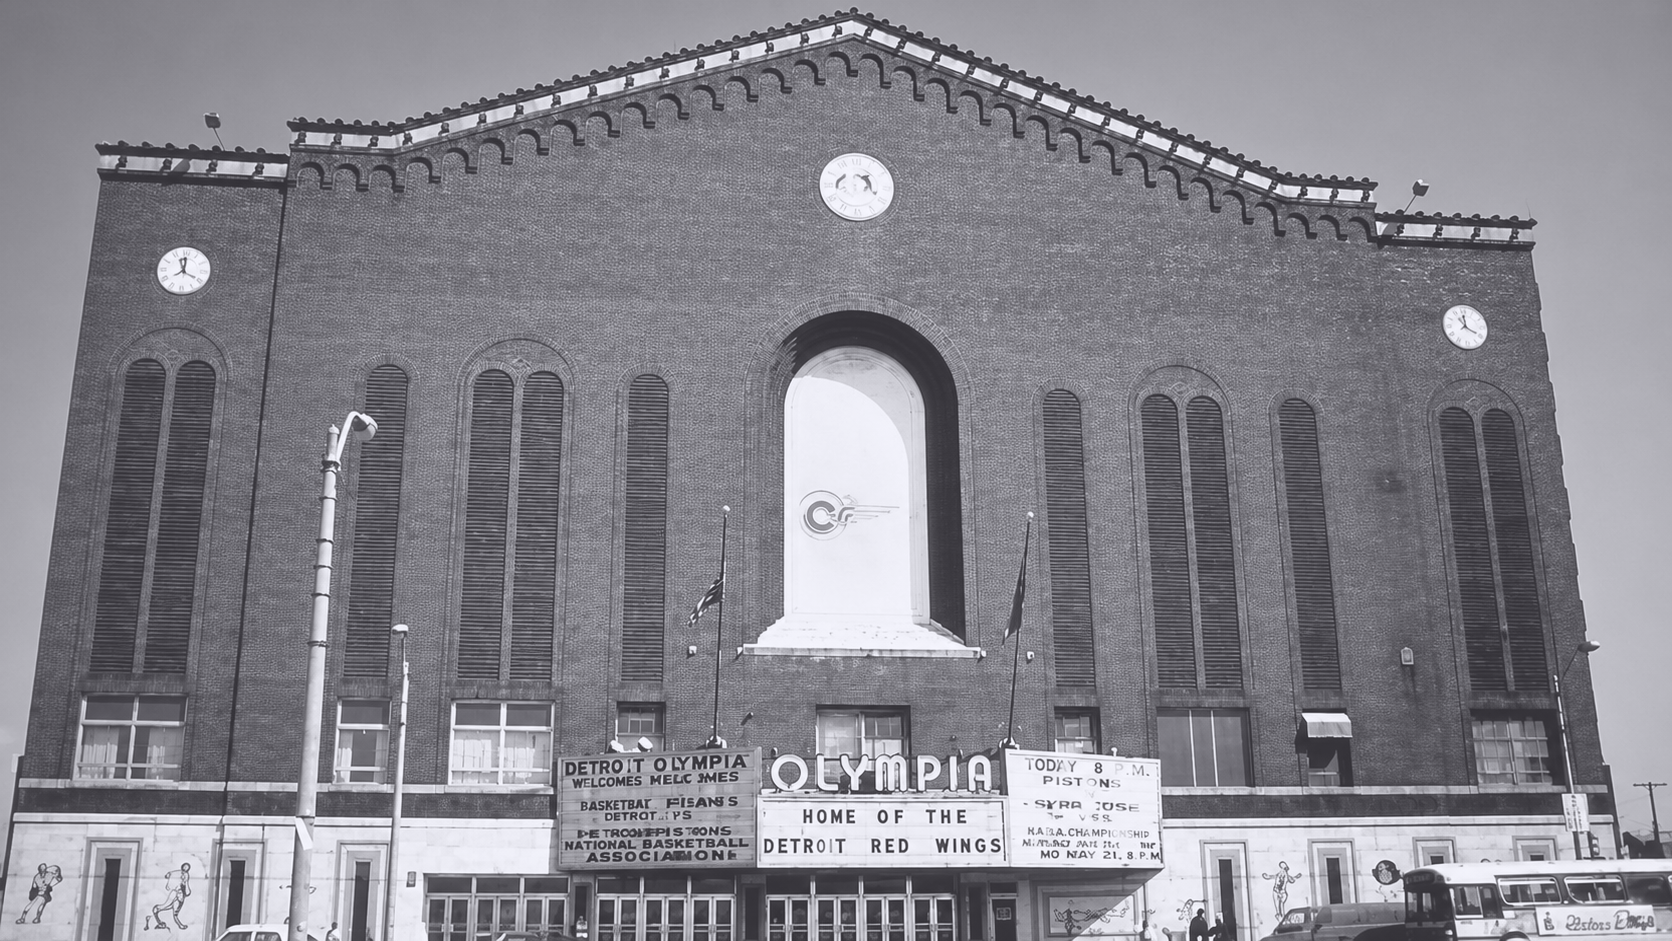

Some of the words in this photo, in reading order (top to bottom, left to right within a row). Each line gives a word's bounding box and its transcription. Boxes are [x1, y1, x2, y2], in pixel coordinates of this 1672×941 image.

[565, 758, 645, 776] DETROIT
[653, 754, 747, 772] OLYMPIA
[770, 753, 992, 792] OLYMPIA
[1025, 757, 1077, 773] TODAY
[1094, 762, 1103, 774] 8
[572, 776, 643, 789] WELCOMES
[1042, 775, 1122, 789] PISTONS
[802, 808, 856, 824] HOME
[877, 808, 904, 824] OF
[925, 808, 967, 824] THE
[564, 840, 637, 851] NATIONAL
[643, 838, 750, 849] BASKETBALL
[763, 837, 847, 854] DETROIT
[871, 837, 909, 854] RED
[935, 837, 1002, 853] WINGS
